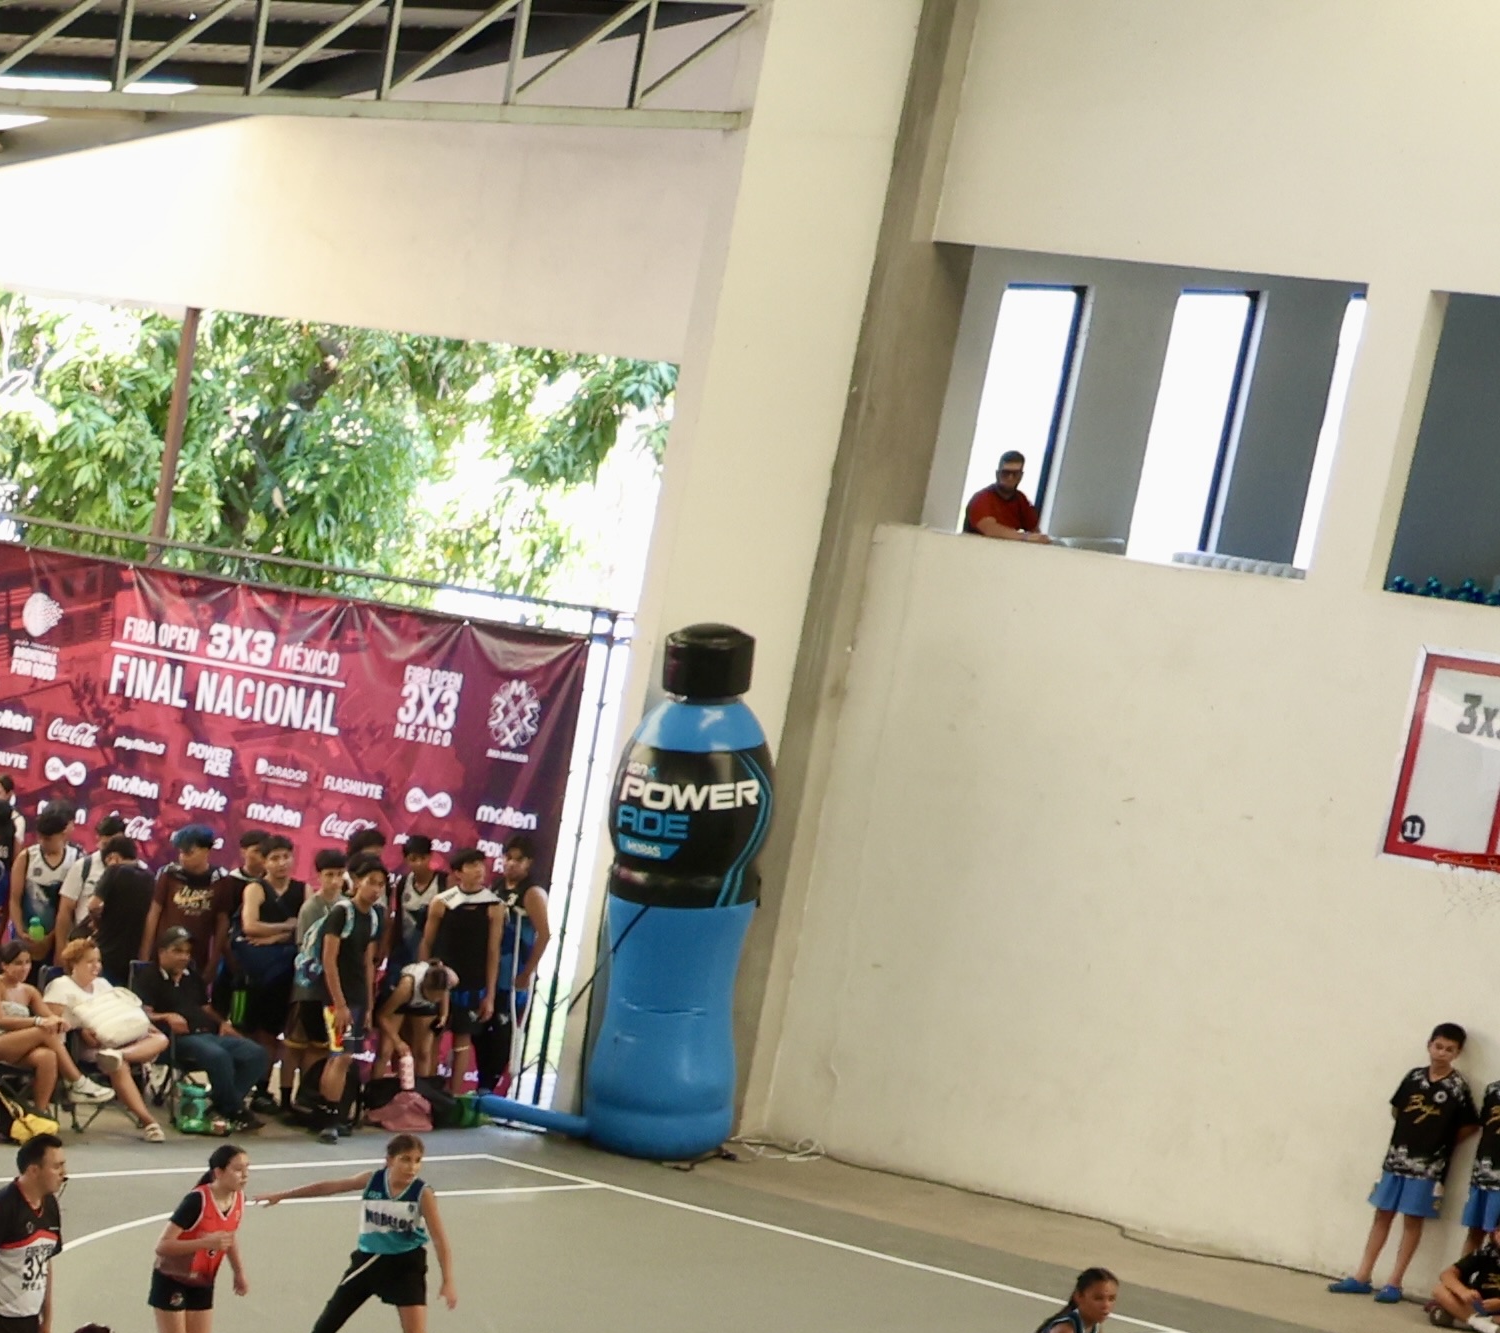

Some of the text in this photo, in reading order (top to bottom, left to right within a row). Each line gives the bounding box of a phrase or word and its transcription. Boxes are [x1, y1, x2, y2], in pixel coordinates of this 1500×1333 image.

[122, 616, 341, 677] FIBA OPEN 3X3 MÉXICO
[108, 653, 340, 737] FINAL NACIONAL
[432, 671, 464, 693] OPEN
[397, 683, 459, 731] 3X3
[47, 716, 101, 748] Coca-Cola
[186, 741, 234, 763] POWER
[203, 760, 231, 778] ADE
[255, 757, 308, 782] DORADOS
[108, 774, 159, 799] molten
[178, 784, 229, 812] Sprite
[323, 775, 384, 800] FLASHLYTE
[619, 774, 761, 811] POWER
[246, 802, 302, 829] molten
[476, 805, 538, 830] molten
[616, 803, 691, 839] ADE
